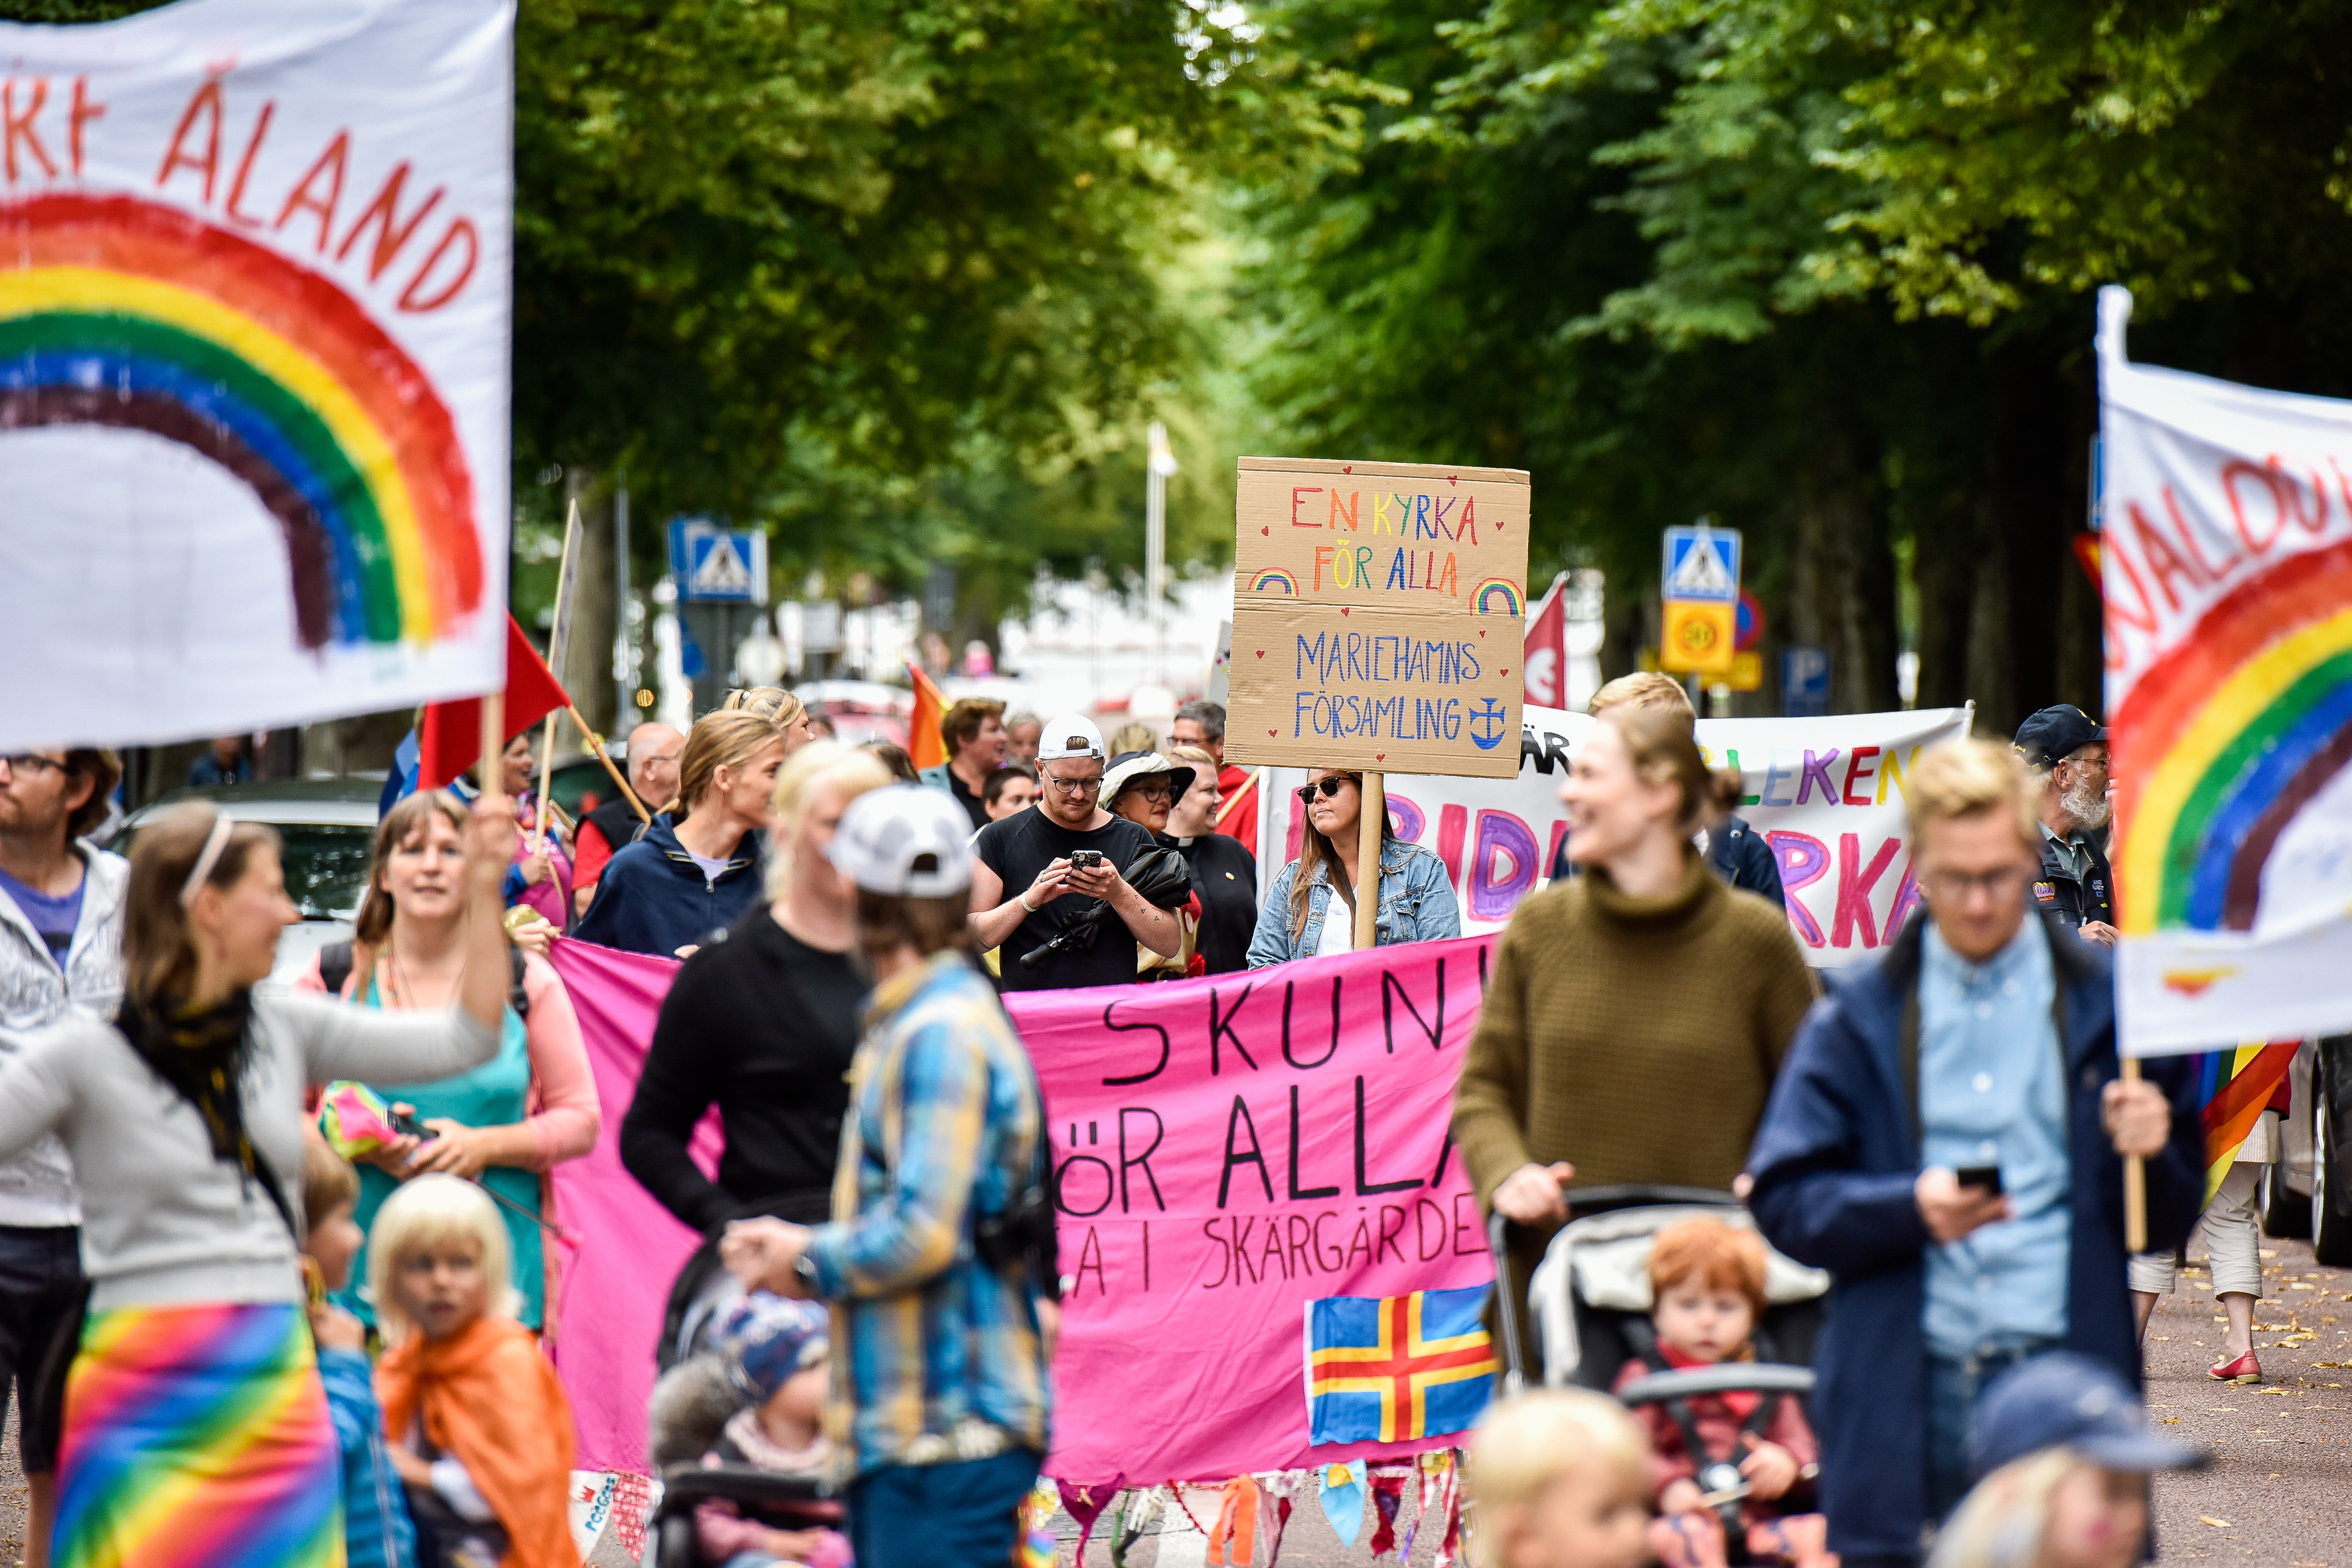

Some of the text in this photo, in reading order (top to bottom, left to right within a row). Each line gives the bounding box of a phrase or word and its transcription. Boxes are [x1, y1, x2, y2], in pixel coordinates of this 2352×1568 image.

[155, 55, 481, 315] ÅLAND
[1292, 487, 1478, 546] EN KYRKA
[1314, 538, 1458, 597] FÖR ALLA
[1296, 631, 1480, 685] MARIEHAMNS
[1294, 690, 1461, 741] FÖRSAMLING
[1143, 1220, 1150, 1293] I
